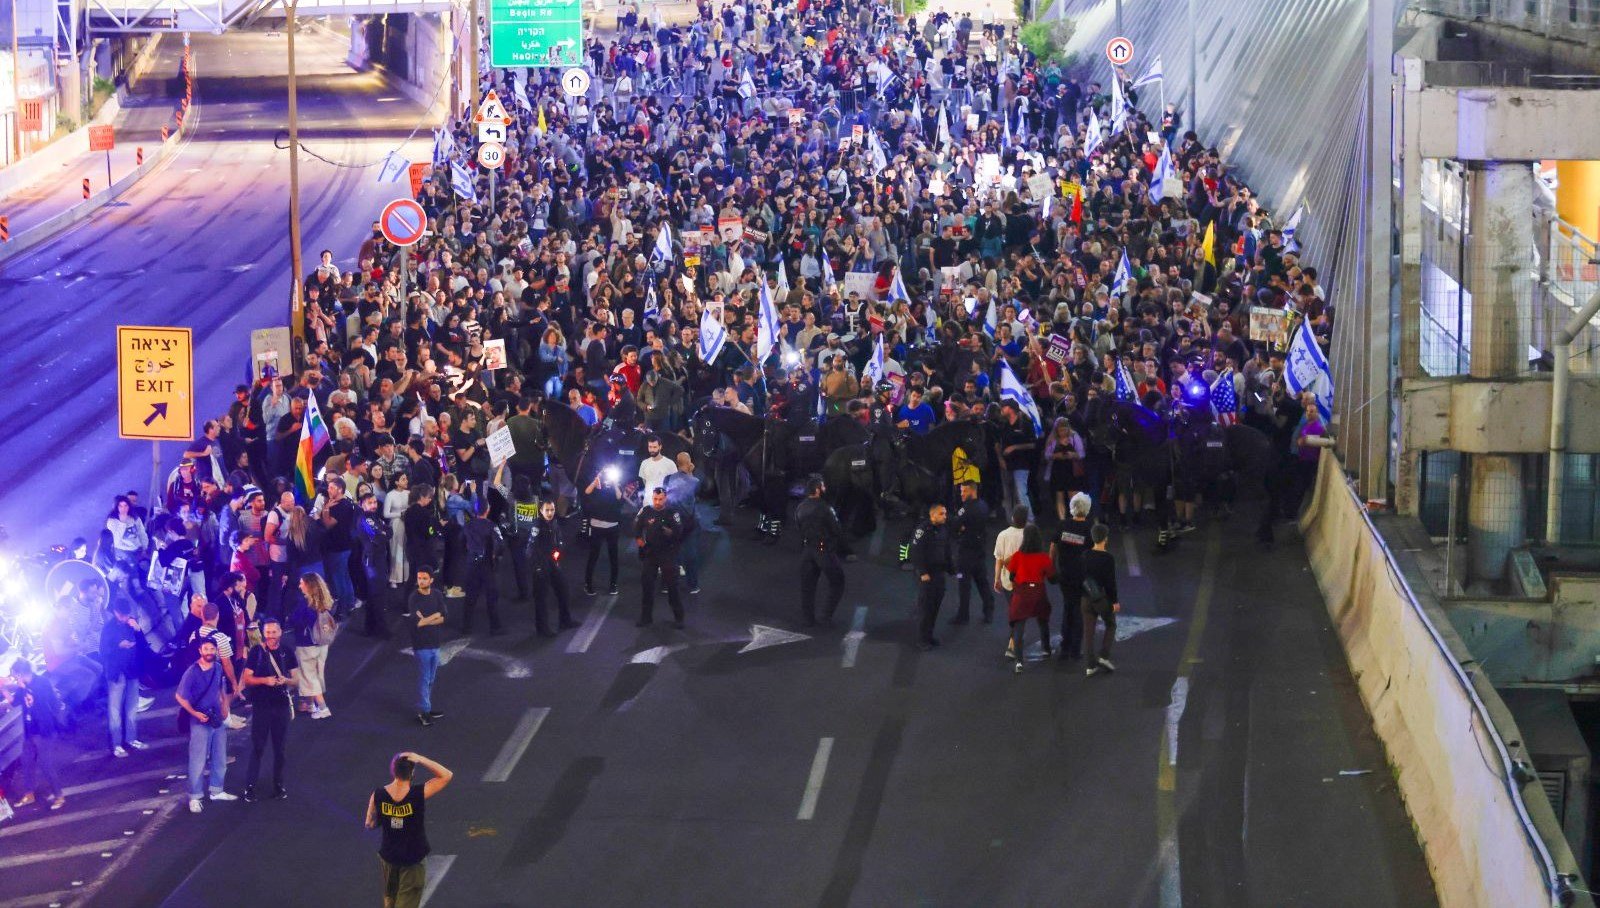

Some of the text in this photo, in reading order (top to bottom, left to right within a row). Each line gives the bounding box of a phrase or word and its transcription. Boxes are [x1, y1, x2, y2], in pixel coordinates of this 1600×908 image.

[509, 9, 536, 18] Begin
[517, 28, 545, 36] הקריה
[484, 151, 499, 161] 30
[131, 338, 178, 351] יציאה
[136, 380, 175, 393] EXIT
